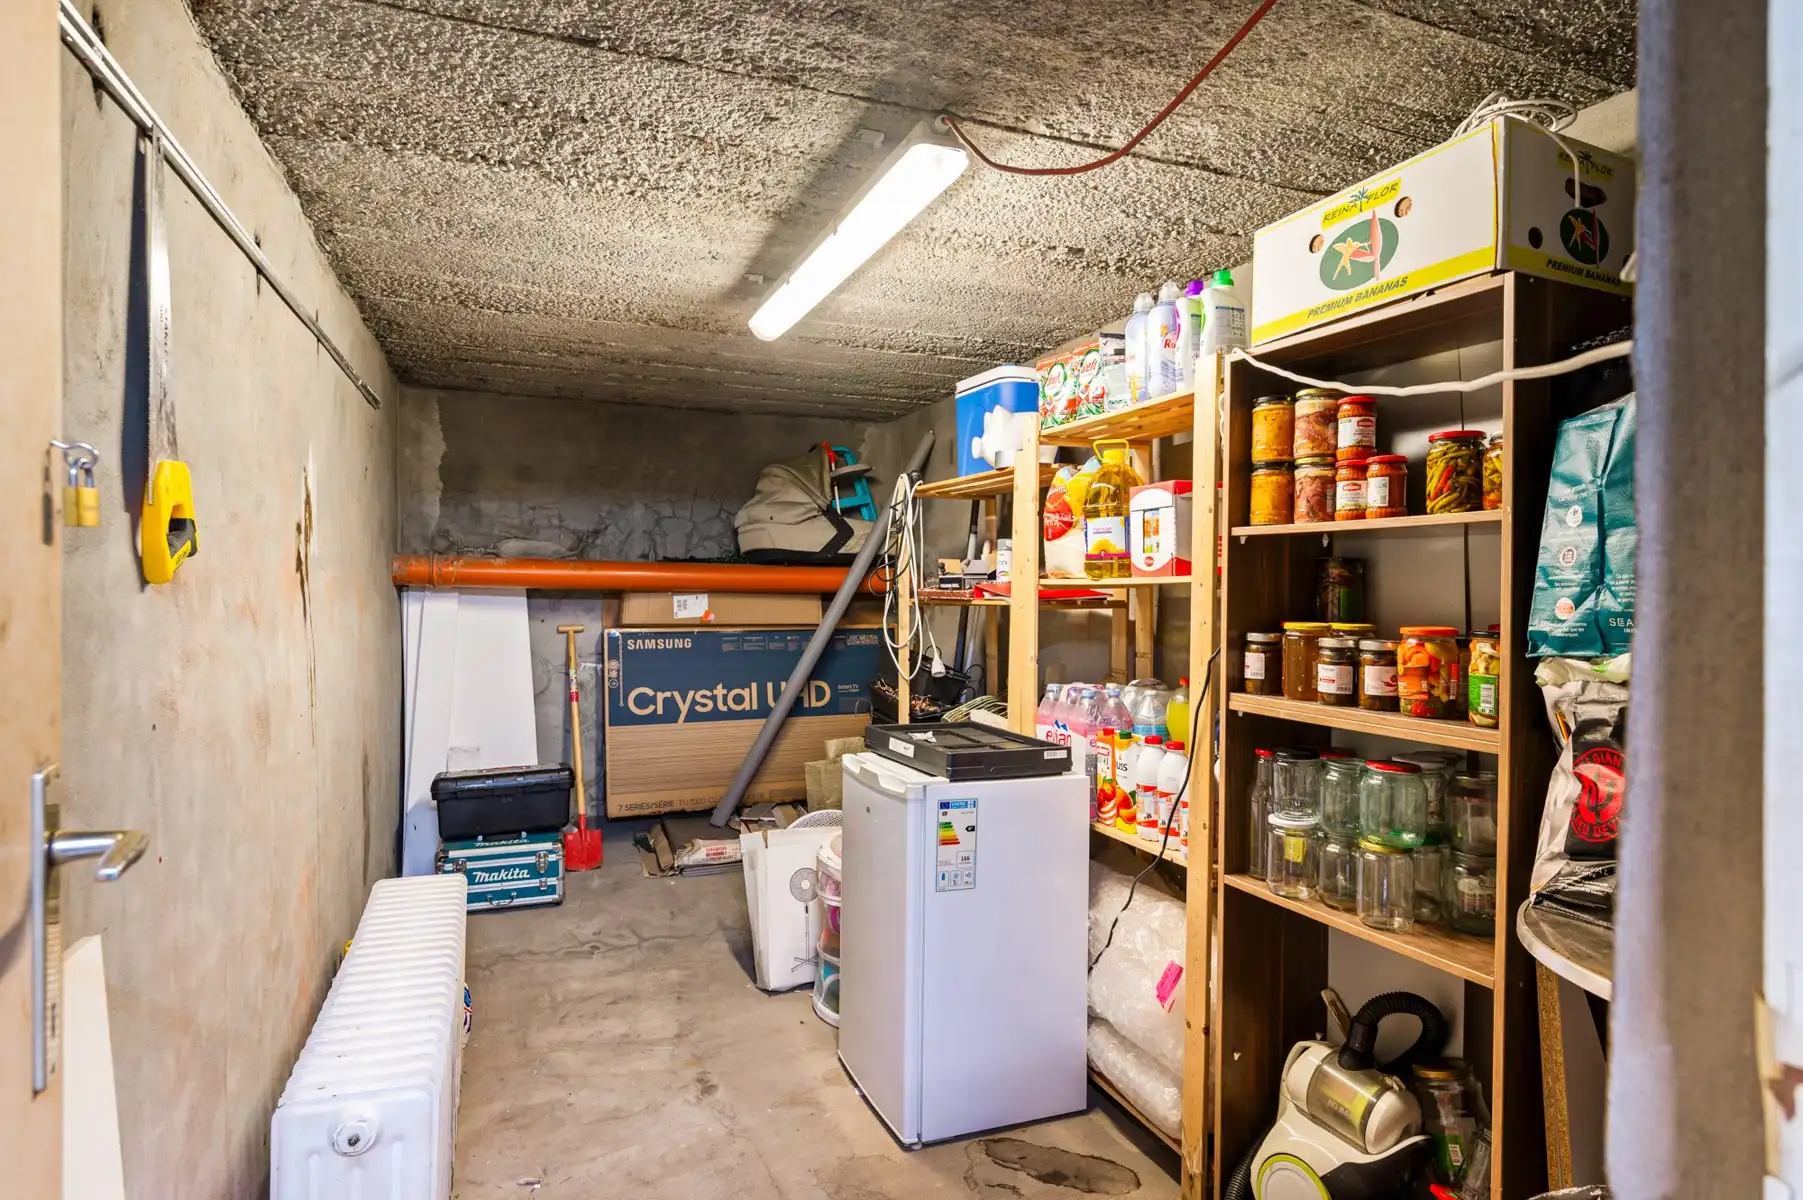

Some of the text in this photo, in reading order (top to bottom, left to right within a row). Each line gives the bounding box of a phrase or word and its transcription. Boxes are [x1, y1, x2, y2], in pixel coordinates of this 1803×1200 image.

[1558, 151, 1585, 166] REIA
[1322, 182, 1399, 224] REINA FLOR
[1546, 258, 1621, 287] PREMIUM BANANAS
[1306, 276, 1409, 319] PREMIUM BANANAS
[627, 637, 692, 650] SAMSUNG
[627, 681, 758, 724] Crystal
[618, 804, 623, 812] 7
